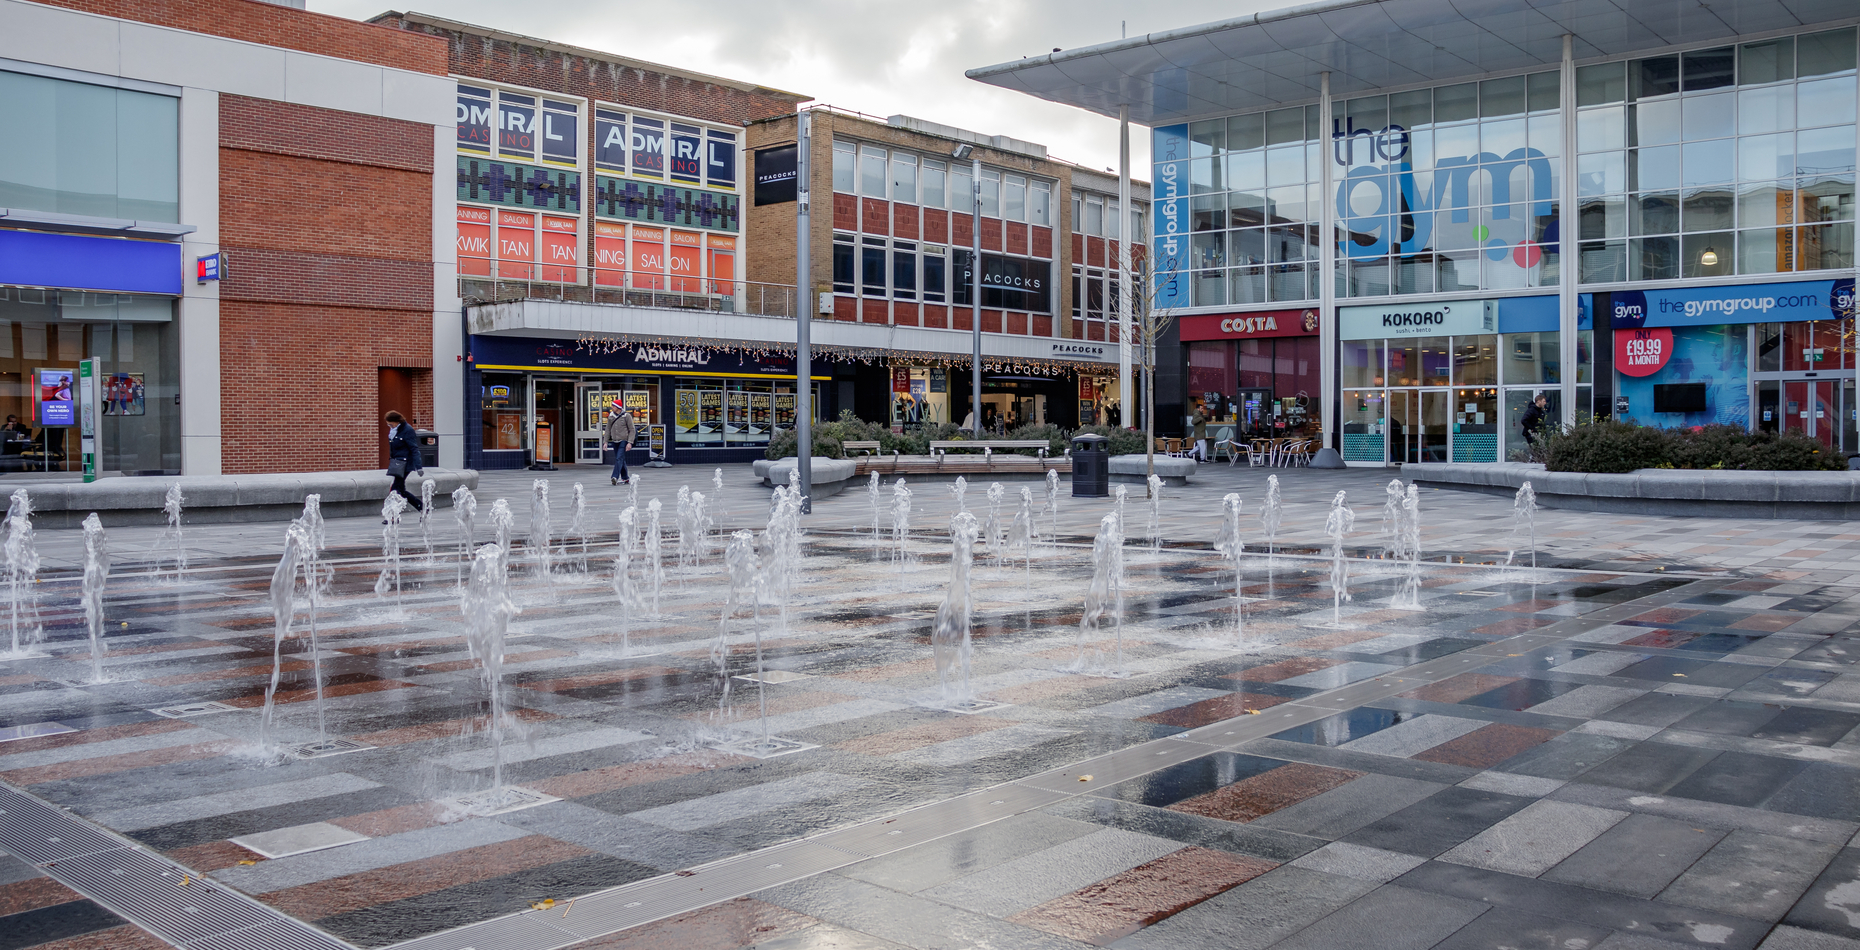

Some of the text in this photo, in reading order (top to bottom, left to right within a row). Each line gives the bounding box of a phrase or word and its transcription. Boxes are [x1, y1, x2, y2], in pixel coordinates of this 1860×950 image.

[457, 103, 563, 141] DMIRAL
[457, 125, 530, 148] CASINO
[1332, 116, 1409, 166] the
[603, 126, 724, 167] ADMIRAL
[634, 153, 697, 174] CASINO
[759, 170, 797, 181] PEACOCKS
[1336, 147, 1552, 262] gym
[457, 210, 528, 225] ANNING SALON
[1162, 135, 1180, 298] thegymgroup.com
[633, 229, 695, 243] TANNING SALON
[457, 236, 489, 253] KWIK
[501, 240, 529, 256] TAN
[641, 253, 690, 271] SALON
[964, 270, 1041, 289] PACOCKS
[1659, 294, 1817, 317] thegymgroup.com
[1837, 294, 1856, 308] gy
[1382, 311, 1444, 327] KOKORO
[1614, 305, 1642, 318] gym
[1220, 316, 1278, 333] COSTA
[1635, 330, 1651, 339] ONLY
[536, 347, 573, 357] CASINO
[1052, 344, 1103, 354] PEACOCKS
[1626, 339, 1662, 357] £19.99
[634, 347, 708, 365] ADMIRAL
[760, 357, 788, 366] CASINO
[1628, 355, 1660, 365] A MONTH
[897, 371, 907, 381] £5
[985, 363, 1059, 376] PEACOCKS
[679, 392, 695, 407] 50
[701, 393, 721, 401] LATEST
[728, 394, 748, 402] LATEST
[775, 401, 793, 409] GAMES
[894, 402, 943, 423] ENVY
